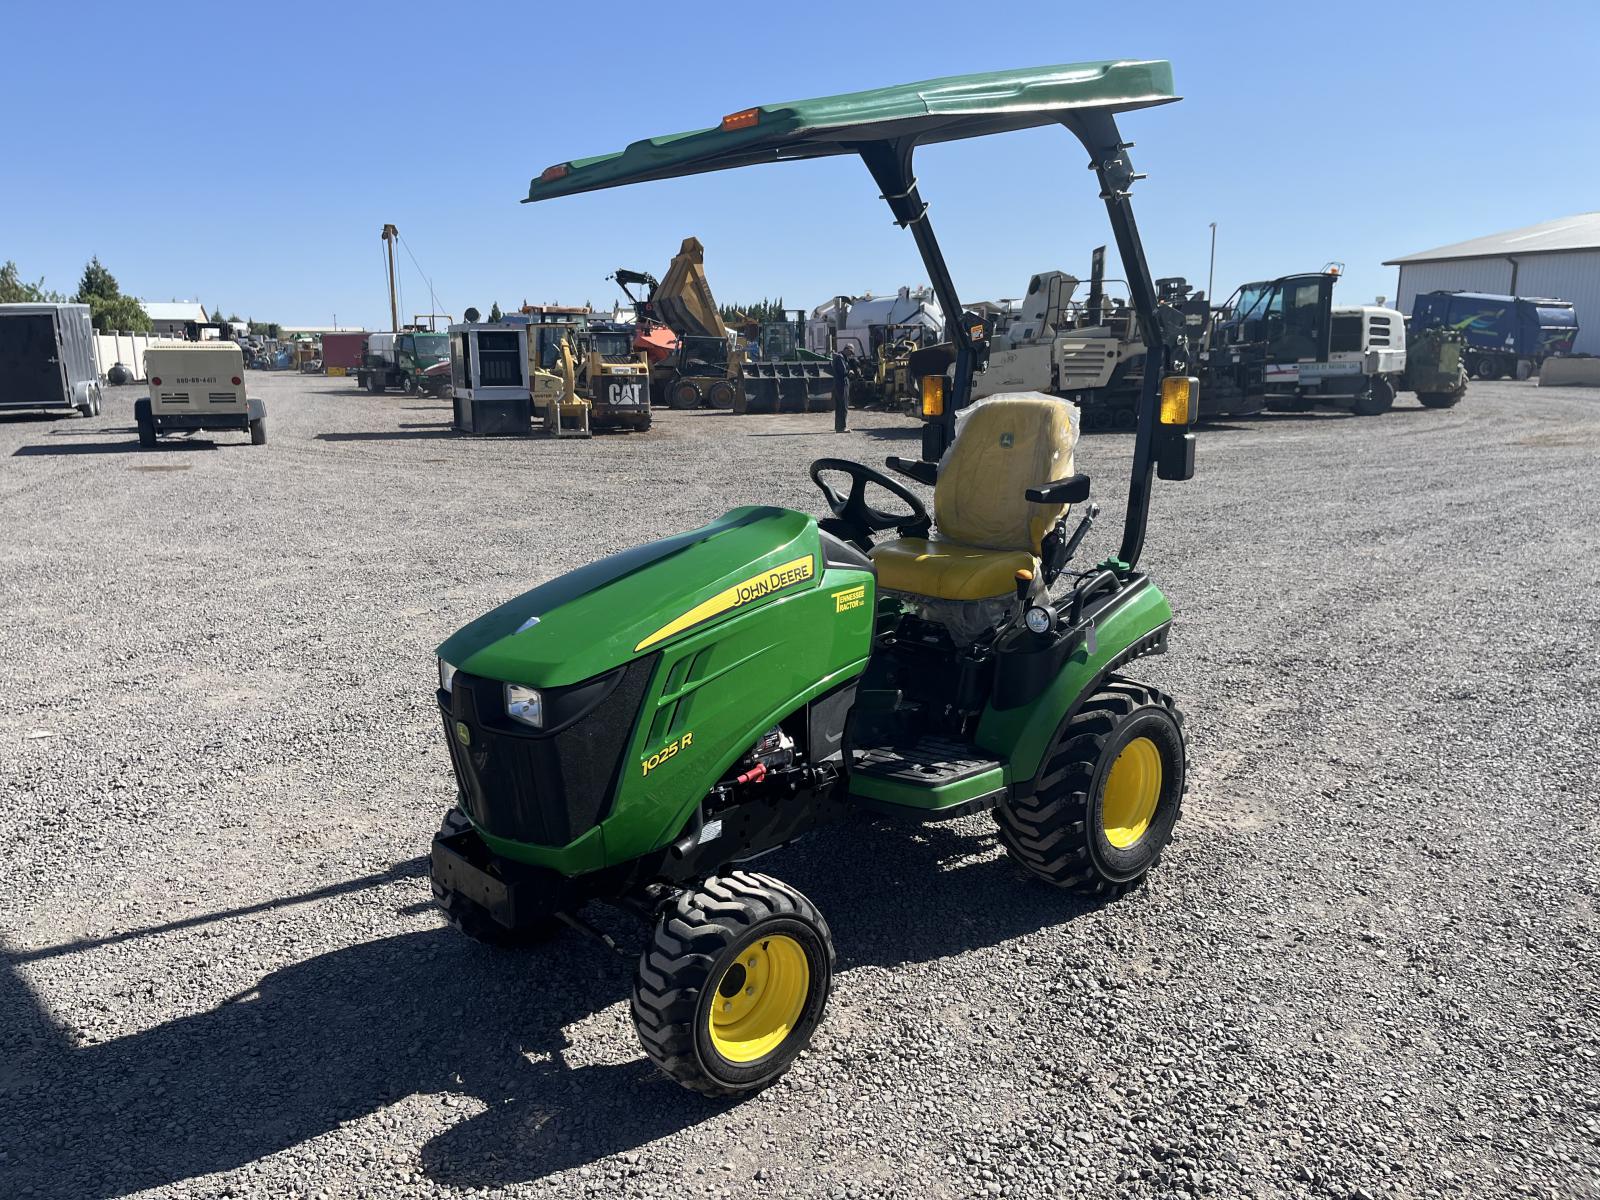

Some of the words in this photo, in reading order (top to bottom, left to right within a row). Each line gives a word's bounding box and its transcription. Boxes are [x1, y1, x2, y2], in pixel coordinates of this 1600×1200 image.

[608, 383, 642, 405] CAT
[734, 579, 768, 605] JOHN
[769, 565, 809, 589] DEERE
[831, 586, 864, 605] TENNESSEE
[641, 740, 679, 777] 1025
[681, 732, 693, 750] R
